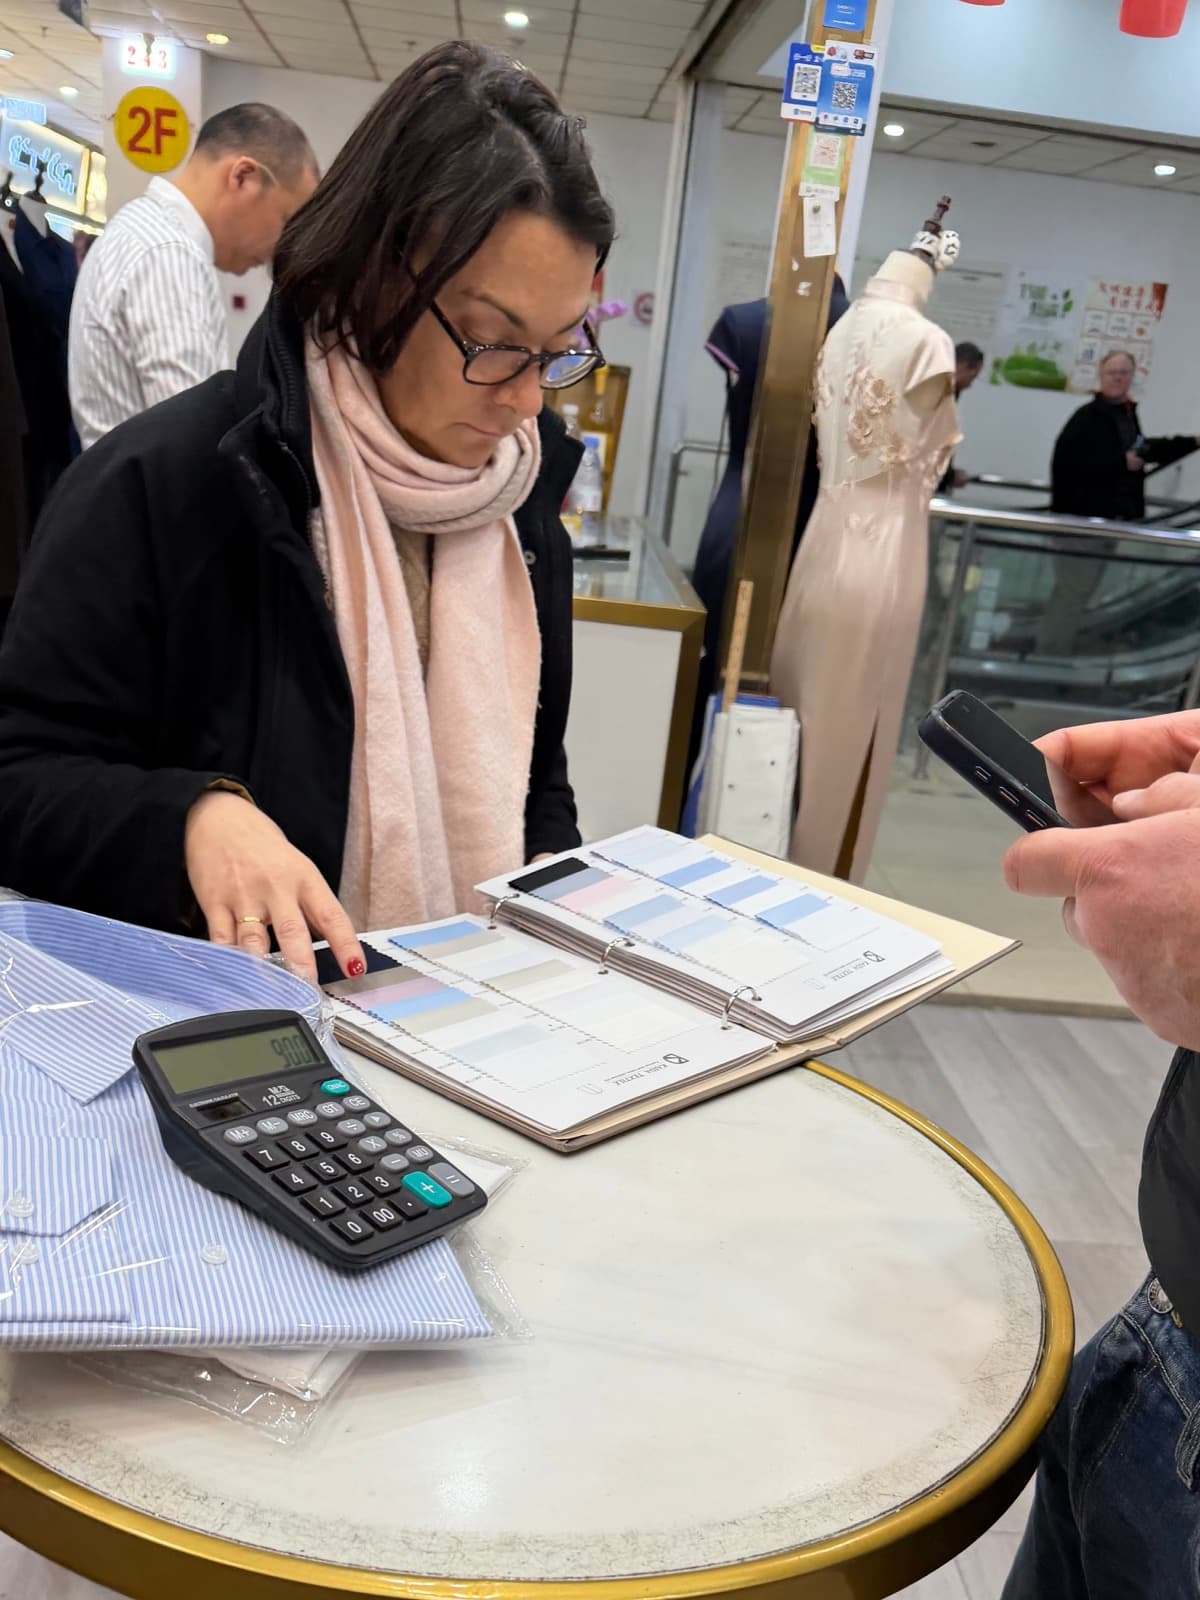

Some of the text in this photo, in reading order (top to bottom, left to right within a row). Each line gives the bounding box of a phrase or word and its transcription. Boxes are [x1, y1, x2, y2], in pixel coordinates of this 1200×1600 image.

[128, 106, 177, 155] 2F
[262, 1094, 280, 1106] 12
[348, 1098, 366, 1107] CE
[322, 1104, 338, 1114] GT
[289, 1110, 314, 1121] MRC
[320, 1131, 335, 1143] 9
[291, 1140, 306, 1152] 8
[258, 1149, 273, 1162] 7
[347, 1153, 362, 1165] 6
[319, 1161, 335, 1174] 5
[291, 1173, 305, 1185] 4
[374, 1176, 390, 1188] 3
[348, 1186, 364, 1198] 2
[319, 1196, 333, 1209] 1
[372, 1208, 396, 1223] 00
[346, 1221, 362, 1234] 0
